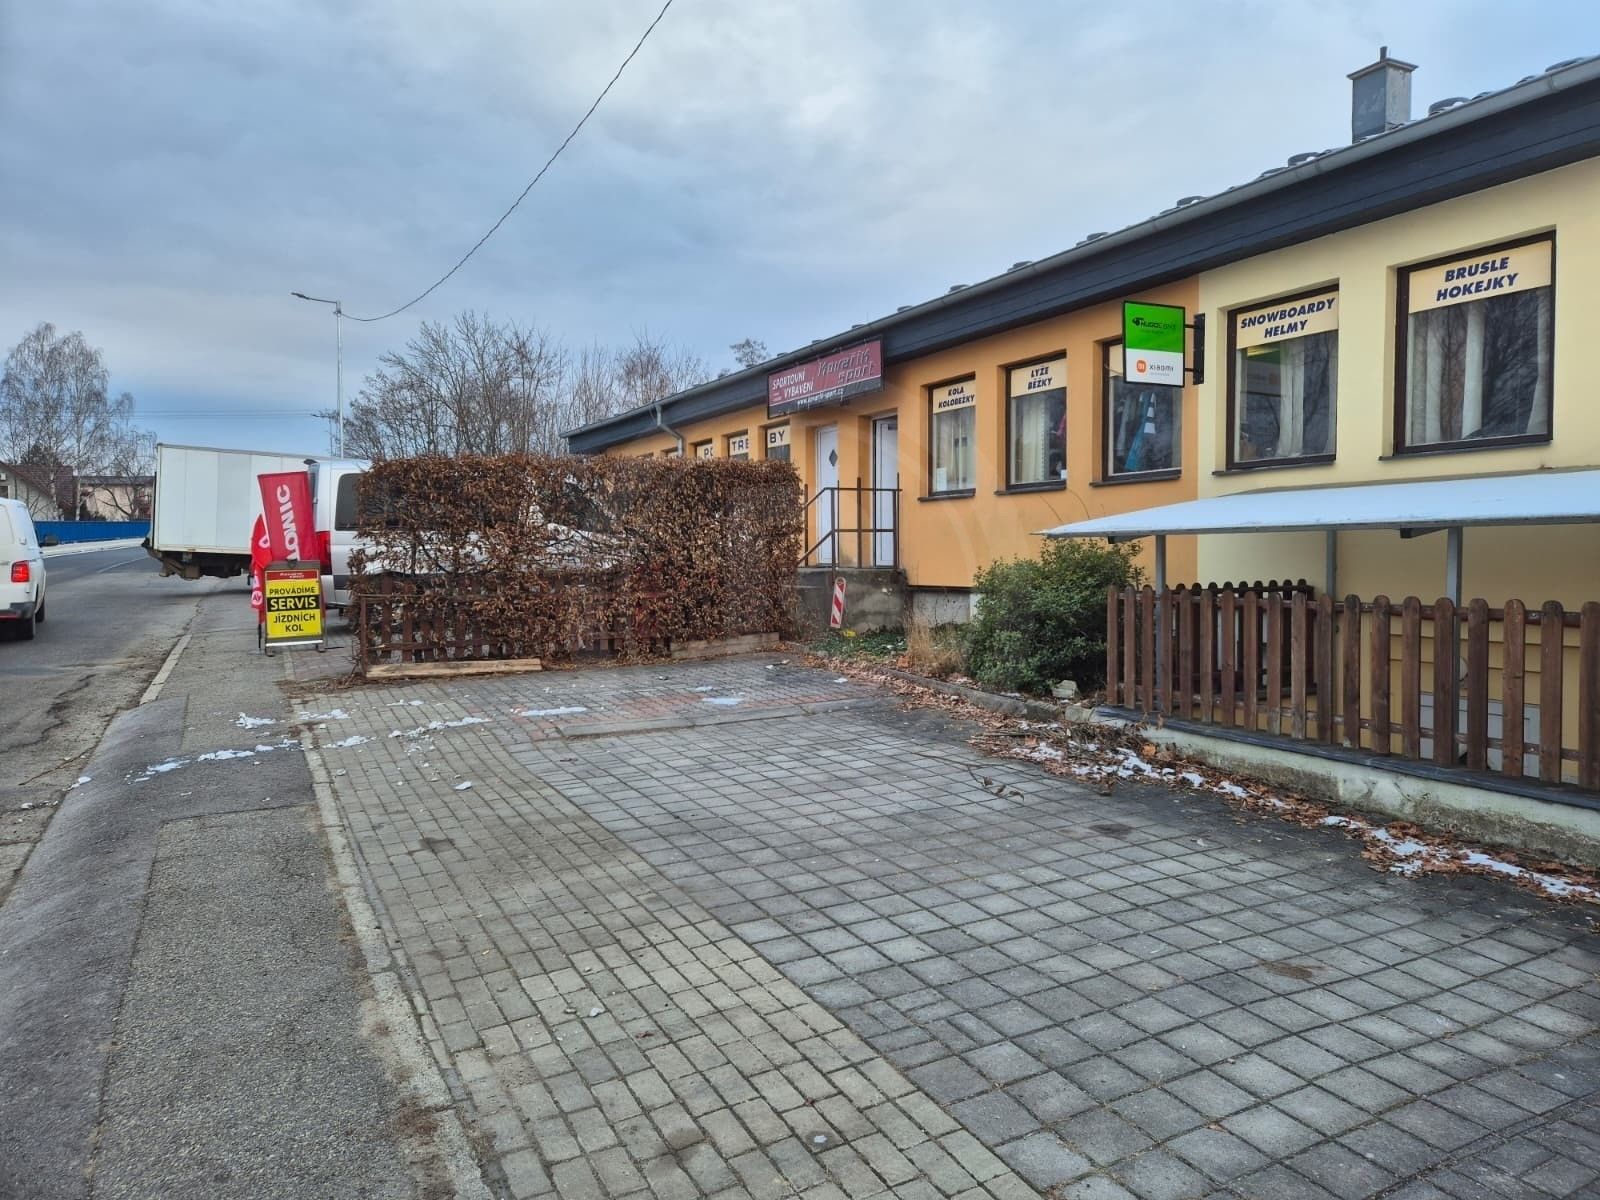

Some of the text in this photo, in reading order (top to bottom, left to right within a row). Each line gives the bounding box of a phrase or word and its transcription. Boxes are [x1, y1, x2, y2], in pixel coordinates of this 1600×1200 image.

[1444, 257, 1510, 282] BRUSLE
[1436, 273, 1519, 302] HOKEJKY
[1240, 297, 1336, 329] SNOWBOARDY
[1264, 320, 1308, 338] HELMY
[1030, 365, 1049, 378] LYŽE
[948, 386, 964, 397] KOLA
[769, 430, 785, 444] BY
[270, 596, 317, 610] SERVIS
[273, 610, 316, 623] JÍZDNÍCH
[285, 624, 304, 632] KOL
